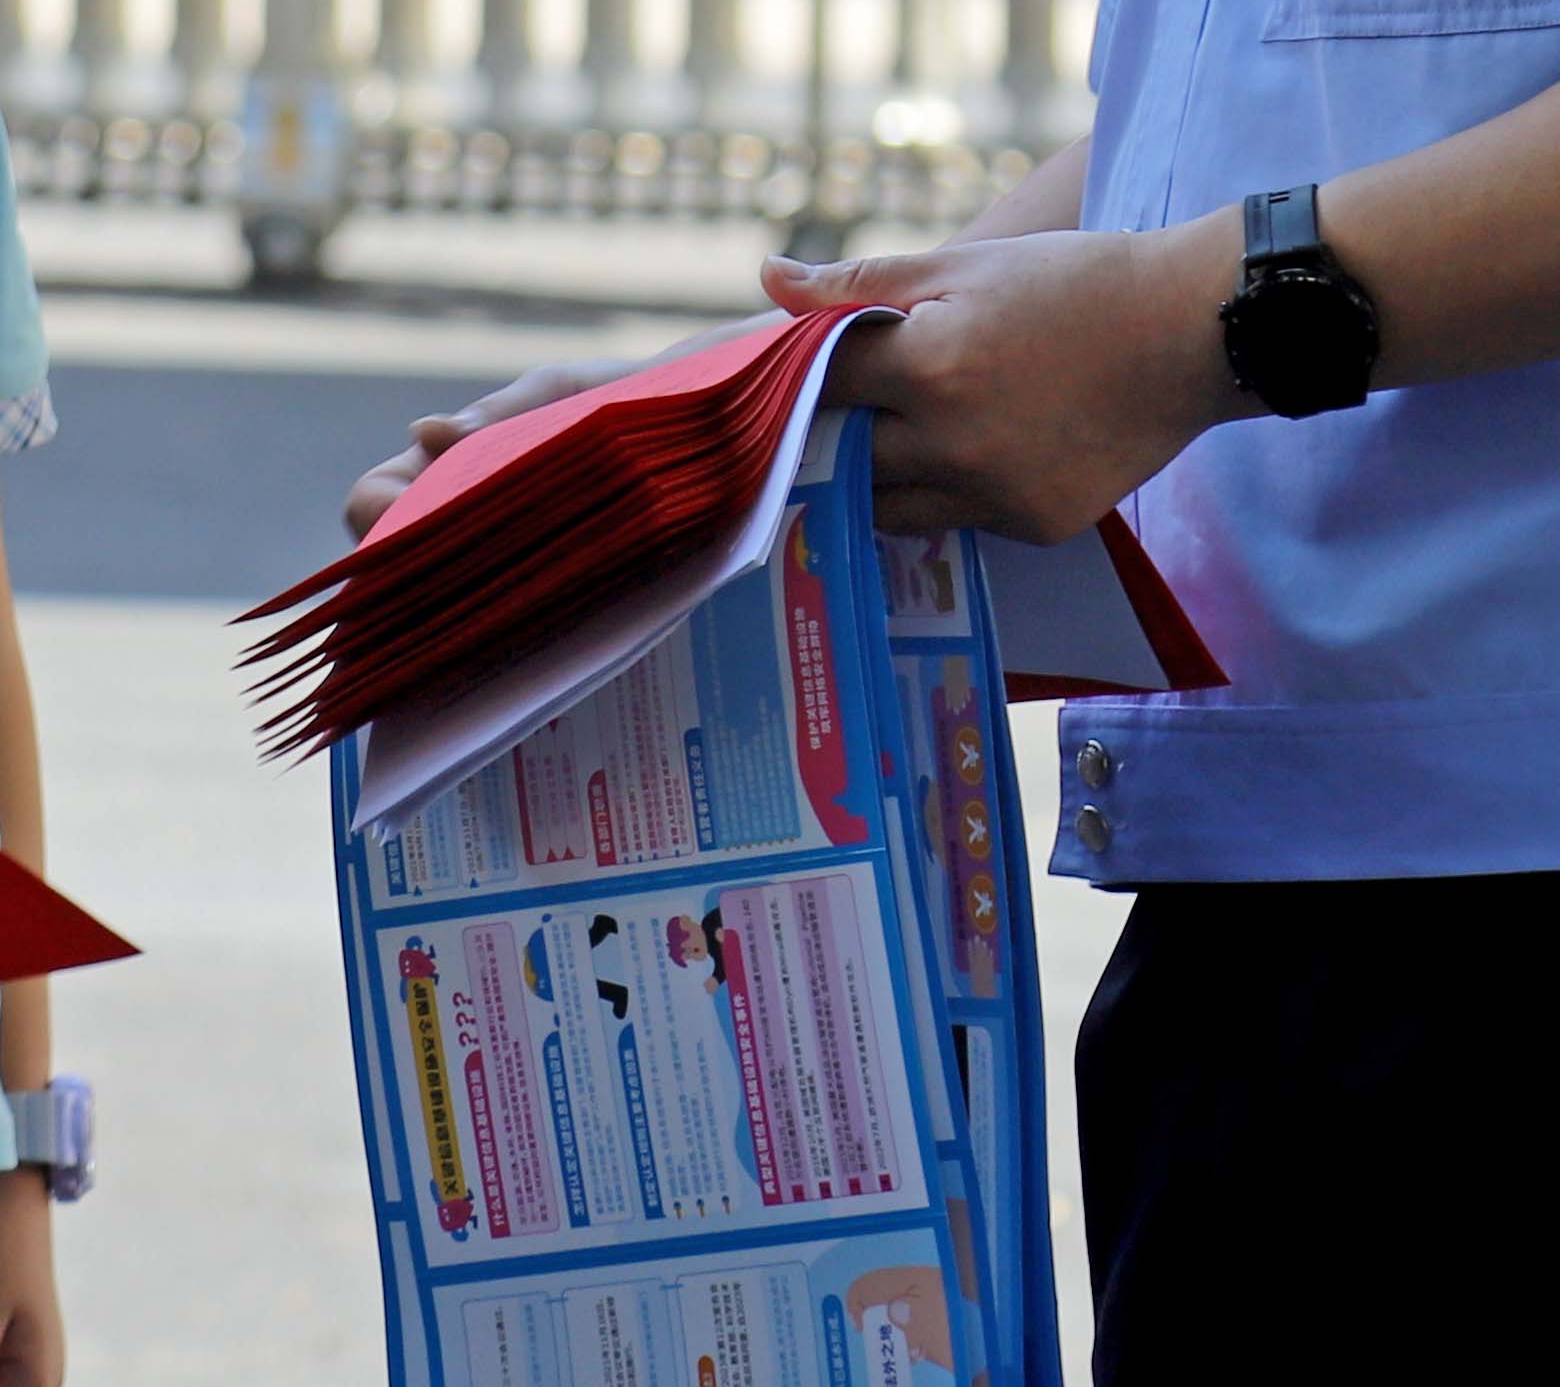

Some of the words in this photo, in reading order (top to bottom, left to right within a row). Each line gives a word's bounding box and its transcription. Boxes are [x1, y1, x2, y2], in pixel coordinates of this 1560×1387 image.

[731, 991, 777, 1195] 典型关键信息基础设施安全事件
